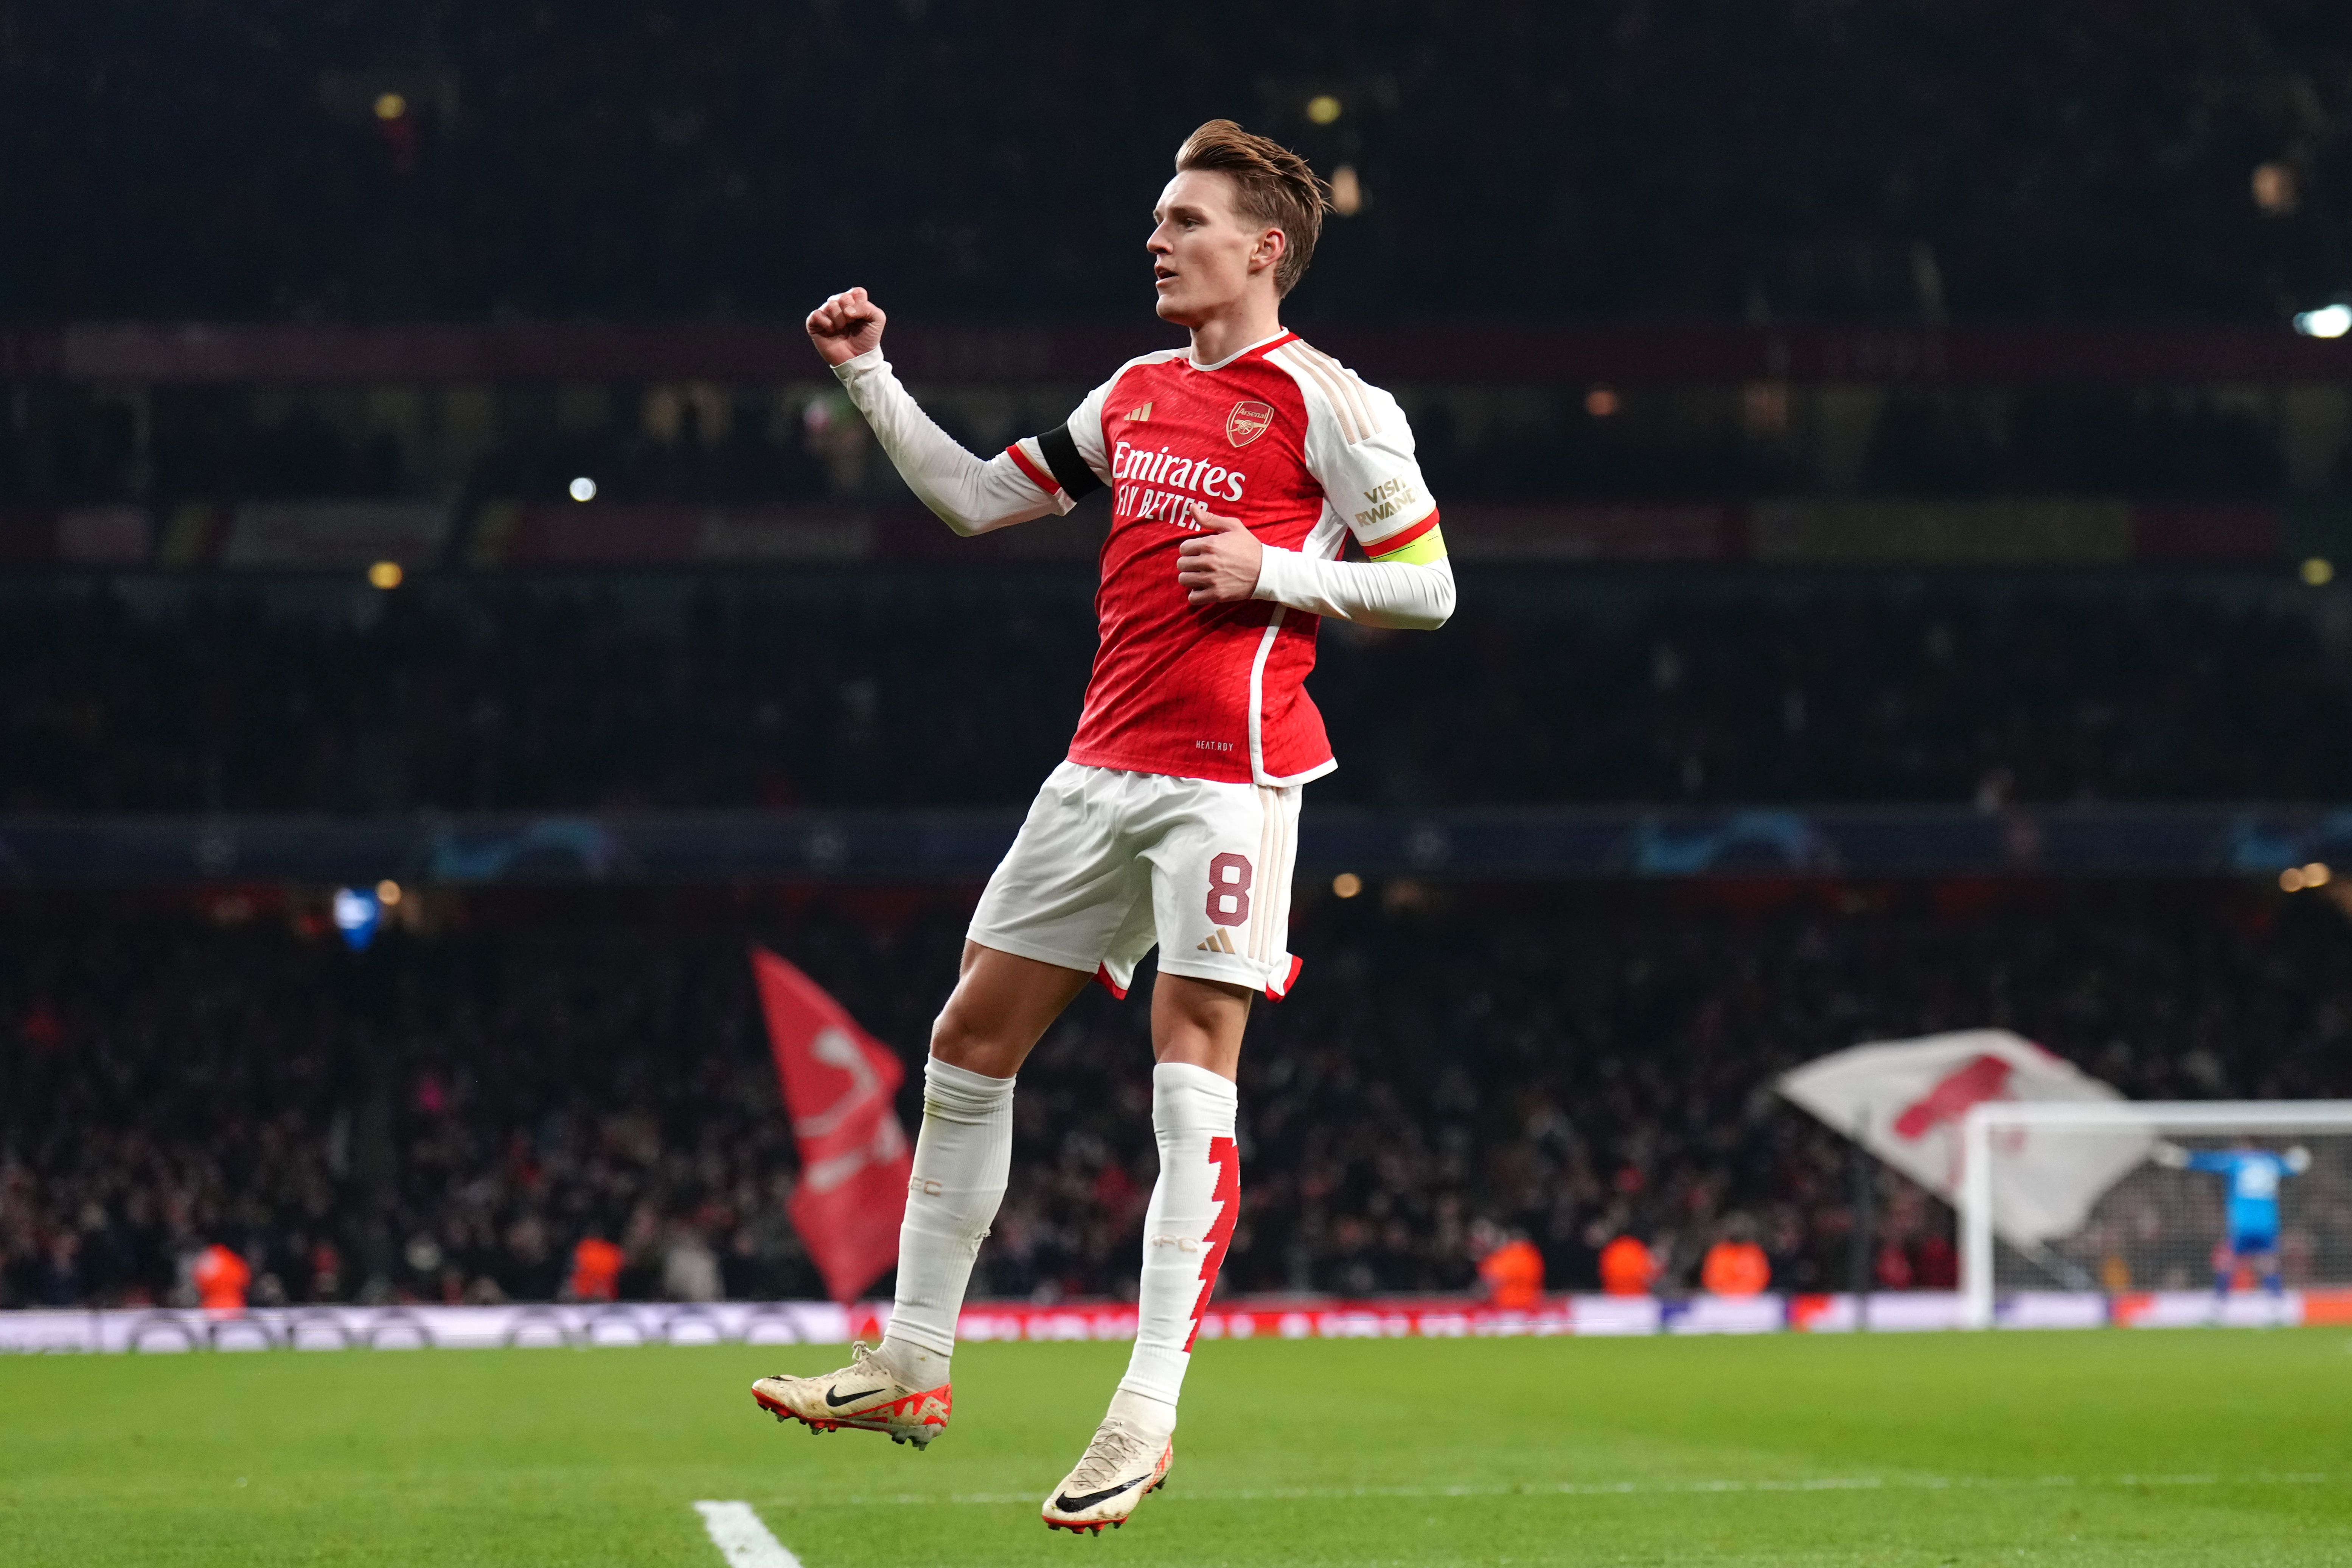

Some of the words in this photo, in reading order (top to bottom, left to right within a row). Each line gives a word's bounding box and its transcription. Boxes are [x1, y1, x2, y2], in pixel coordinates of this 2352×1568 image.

[1238, 408, 1268, 419] Arsenal
[1112, 441, 1246, 502] Emirates
[1363, 474, 1406, 504] VISIT
[1116, 485, 1139, 516] FLY
[1136, 489, 1208, 531] BETTER
[1196, 740, 1233, 751] HEAT.RDY
[1206, 852, 1252, 927] 8
